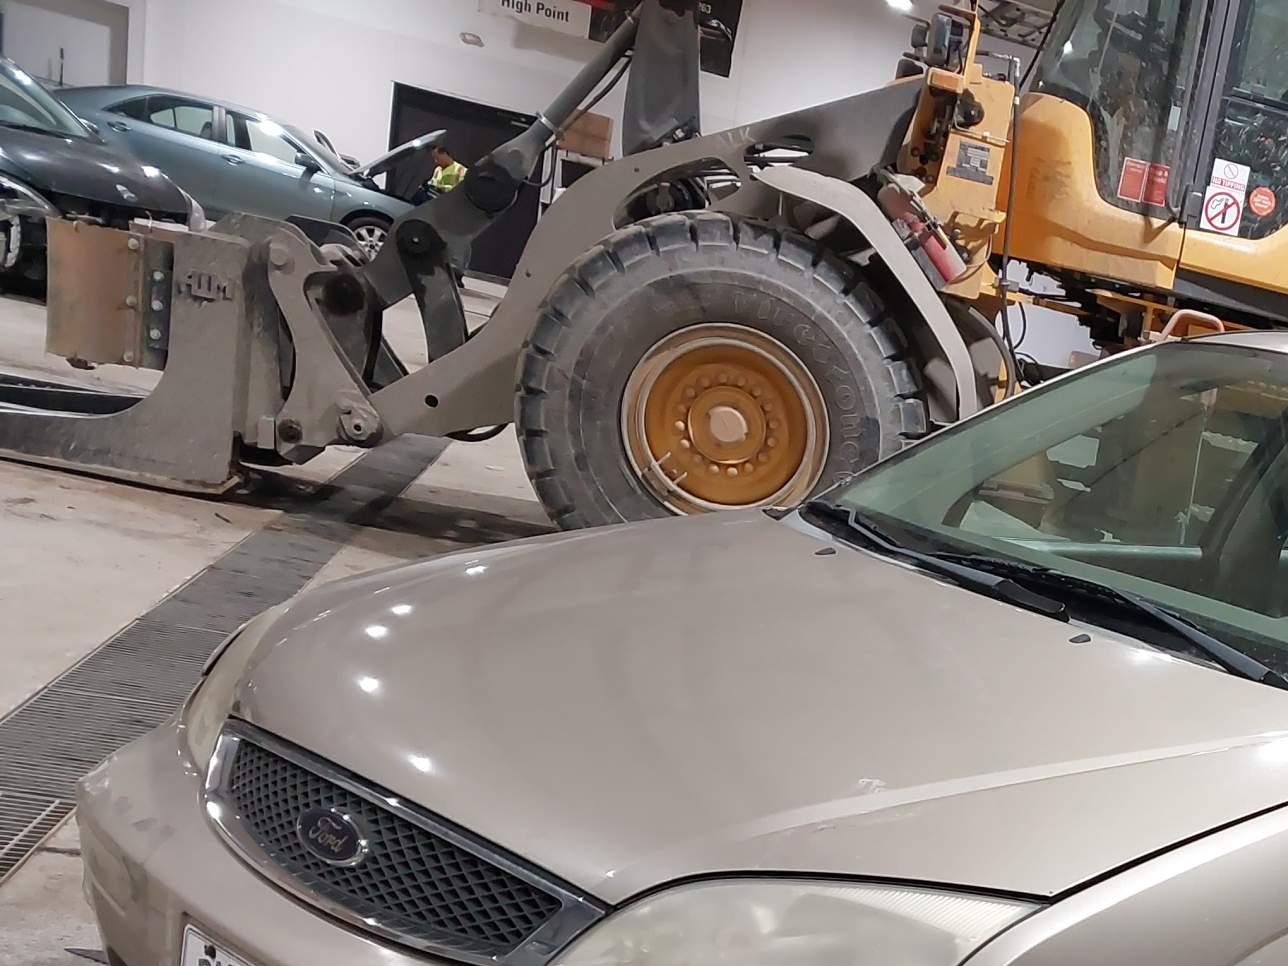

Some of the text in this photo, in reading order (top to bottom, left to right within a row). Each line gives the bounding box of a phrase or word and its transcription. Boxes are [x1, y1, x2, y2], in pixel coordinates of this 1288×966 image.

[501, 0, 569, 22] High Point
[309, 816, 349, 853] Ford
